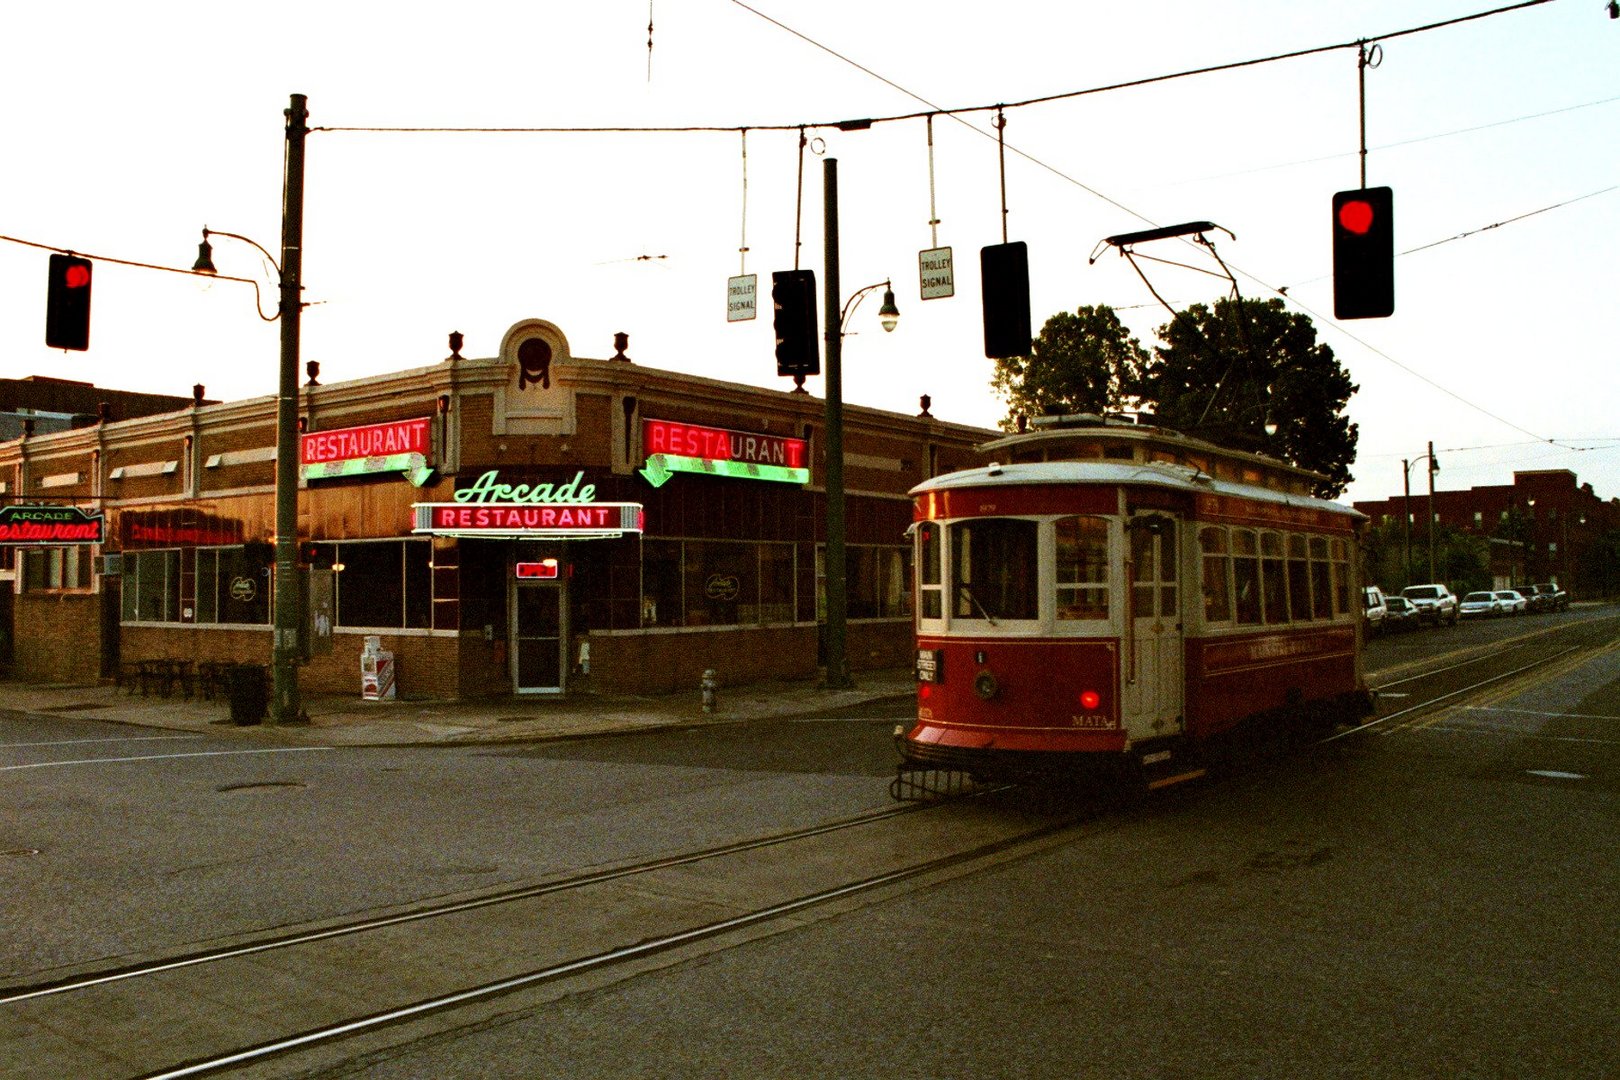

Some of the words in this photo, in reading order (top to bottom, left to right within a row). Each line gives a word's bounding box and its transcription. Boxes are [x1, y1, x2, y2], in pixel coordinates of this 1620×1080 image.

[922, 258, 951, 271] TROLLEY
[729, 284, 755, 296] TROLLEY
[922, 276, 952, 289] SIGNAL
[729, 300, 755, 312] SIGNAL
[306, 423, 425, 461] RESTAURANT
[652, 424, 802, 466] RESTAURANT
[453, 469, 596, 504] Arcade
[10, 511, 74, 521] ARCADE
[441, 508, 609, 527] RESTAURANT
[0, 521, 99, 540] estaurant
